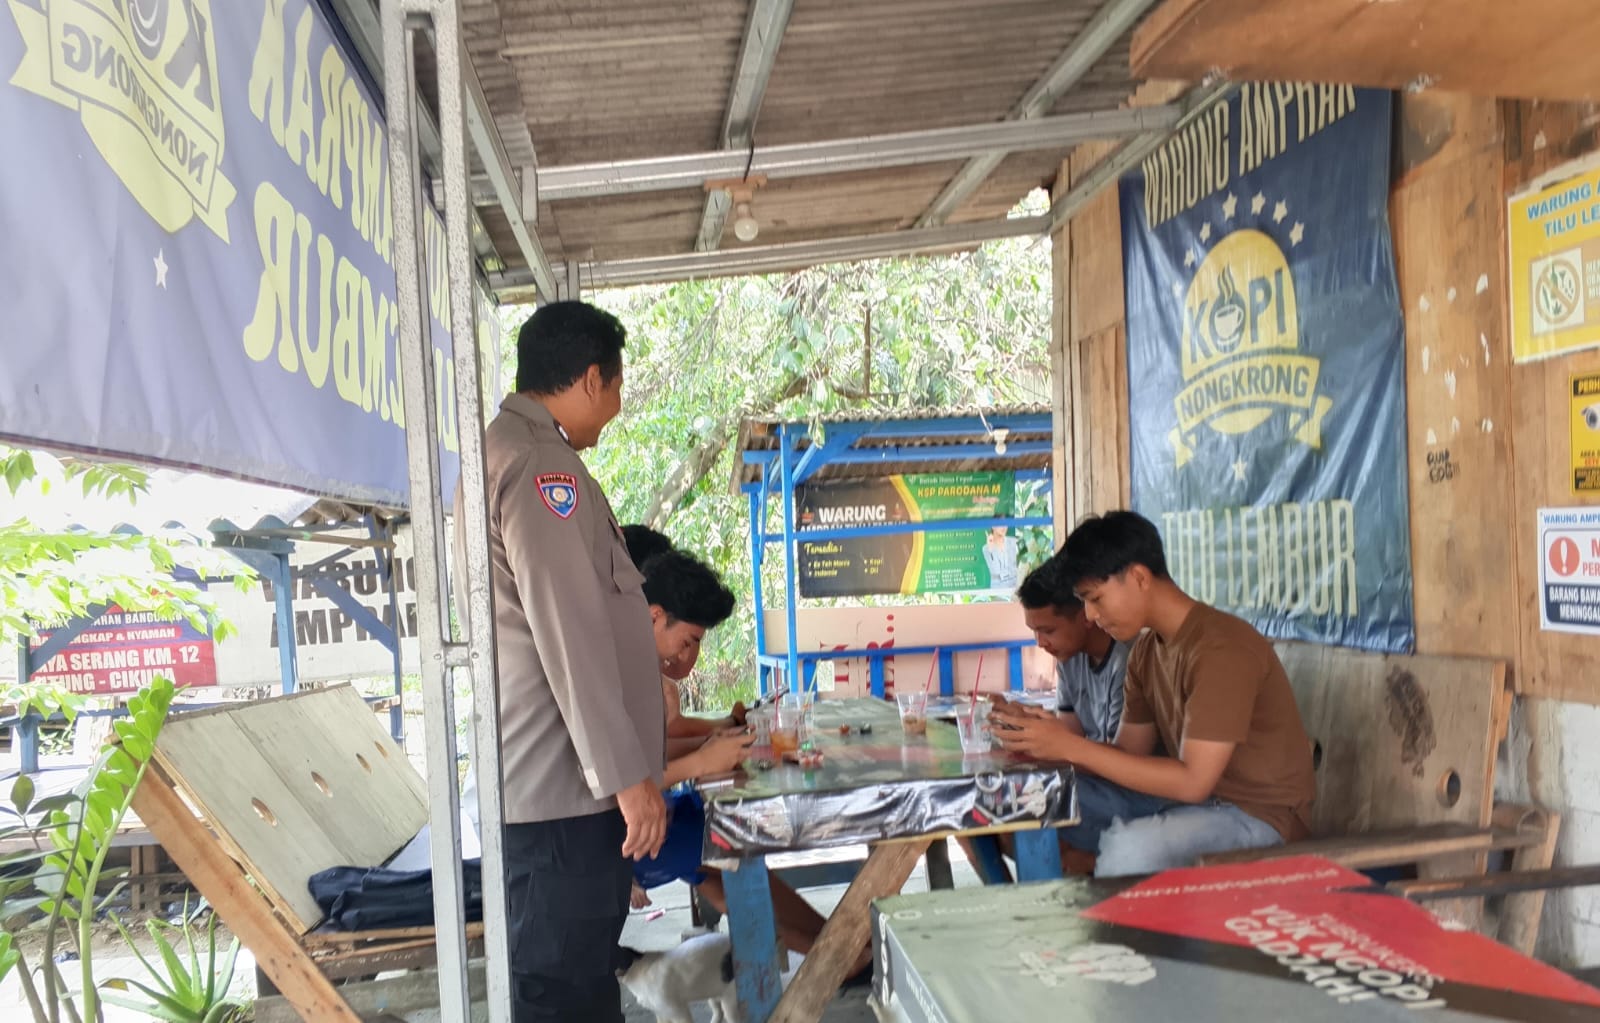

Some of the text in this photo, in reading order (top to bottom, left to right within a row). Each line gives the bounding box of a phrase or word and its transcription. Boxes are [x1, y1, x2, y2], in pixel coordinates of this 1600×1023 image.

[1142, 100, 1229, 232] WARUNG
[1527, 183, 1591, 220] WARUNG
[1544, 212, 1576, 237] TILU
[1188, 267, 1287, 364] KOPI
[1180, 363, 1309, 423] NONGKRONG
[819, 504, 886, 523] WARUNG
[1544, 513, 1577, 524] WARUNG
[1224, 499, 1357, 617] LEMBUR
[1549, 586, 1579, 604] BARANG
[127, 627, 175, 640] NYAMAN
[70, 649, 139, 671] SERANG
[143, 647, 176, 666] KM.
[179, 645, 199, 663] 12
[1251, 904, 1446, 1010] YUK NGOPI
